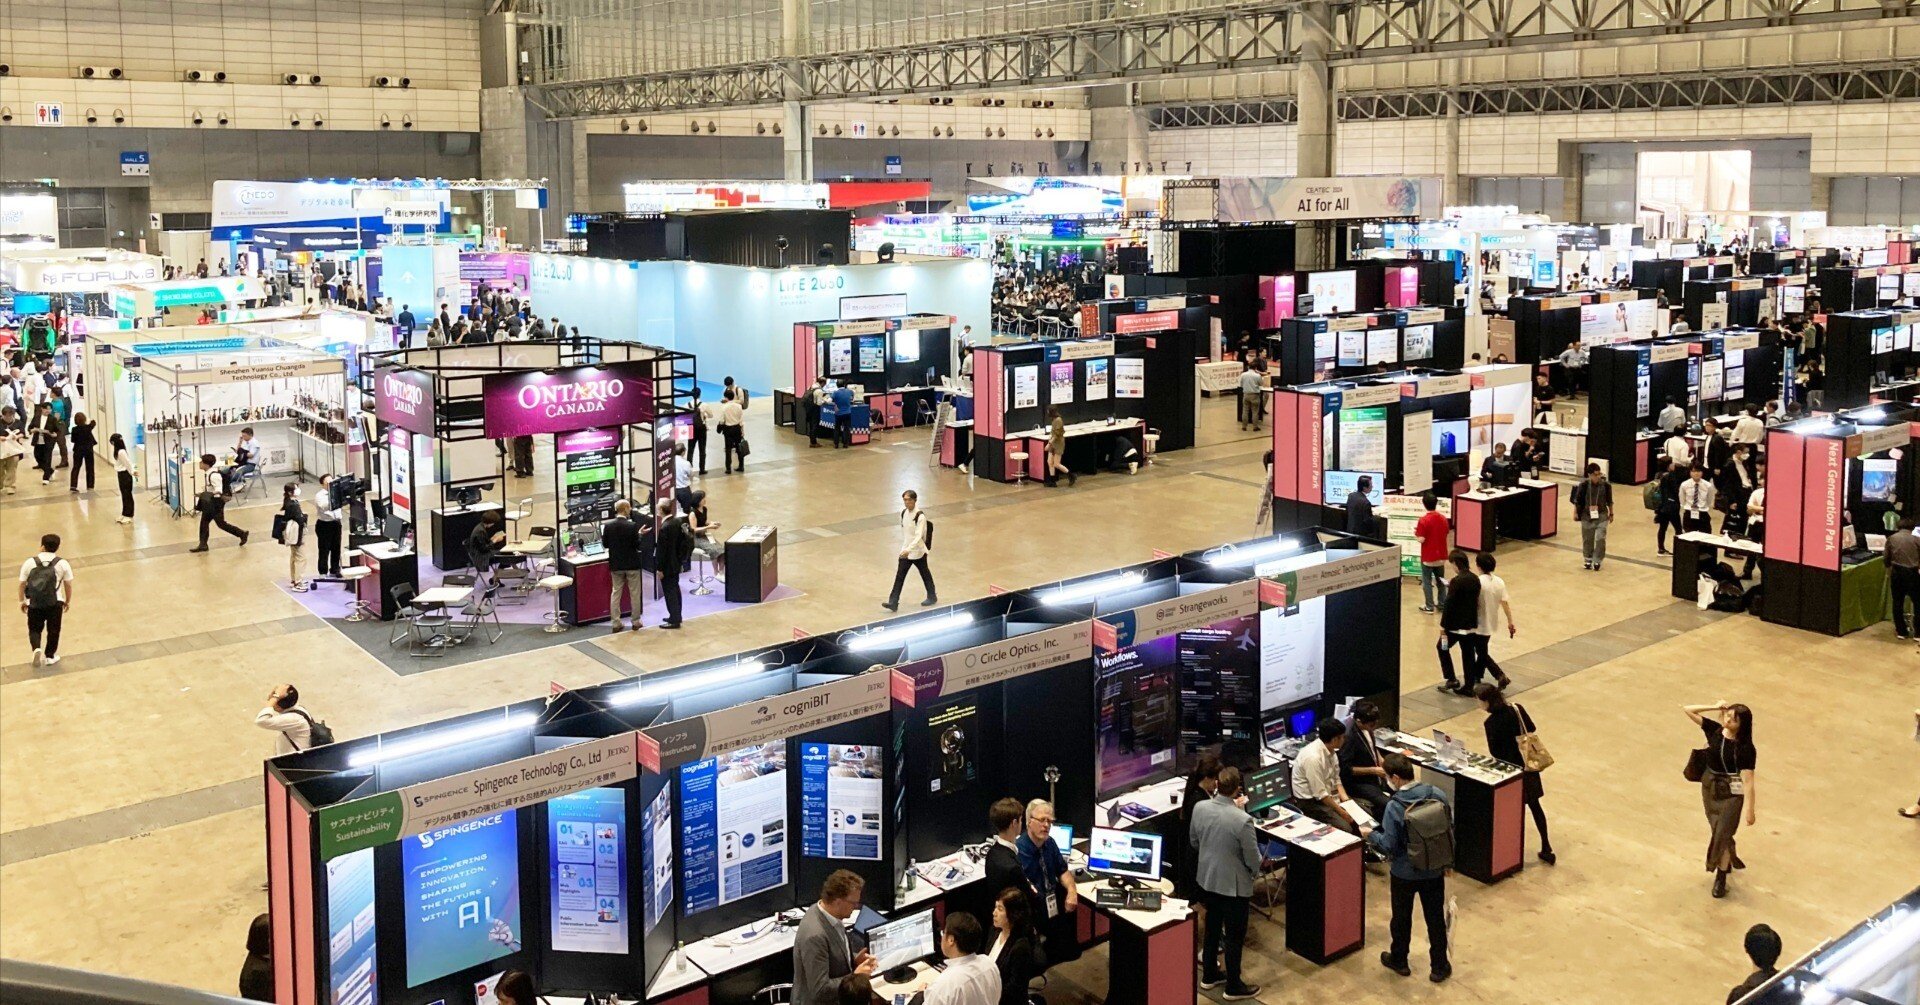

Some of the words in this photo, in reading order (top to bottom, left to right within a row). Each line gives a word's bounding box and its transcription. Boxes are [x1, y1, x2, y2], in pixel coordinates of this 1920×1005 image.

[139, 154, 144, 162] 5
[247, 191, 274, 199] NEDO
[394, 210, 438, 218] 理化学研究所
[1298, 199, 1311, 212] AI
[1316, 198, 1332, 212] for
[1334, 198, 1349, 210] All
[276, 364, 305, 372] Chuangda
[384, 374, 422, 406] ONTARIO
[518, 379, 624, 409] ONTARIO
[394, 398, 415, 415] CANADA
[546, 401, 605, 418] CANADA
[1828, 442, 1838, 466] Next
[1826, 470, 1838, 526] Generation
[1826, 528, 1836, 551] Park
[1320, 569, 1340, 579] Atmosic
[1342, 562, 1374, 574] Technologies
[1179, 595, 1228, 615] Strangeworks
[980, 650, 1007, 664] Circle
[1044, 638, 1059, 648] Inc.
[1101, 650, 1138, 668] Workflows.
[783, 693, 831, 715] cogniBIT
[866, 682, 885, 693] JETRO
[662, 732, 687, 744] インフラ
[424, 787, 468, 803] SPINGENCE
[474, 773, 518, 797] Spingence
[521, 761, 567, 783] Technology
[570, 755, 586, 769] Co.,
[589, 751, 601, 764] Ltd
[606, 745, 629, 760] JETRO
[424, 771, 616, 828] デジタル競争力の強化に資する包括的AIソリューションを提供
[330, 806, 394, 829] サステナビリティ
[336, 822, 391, 841] Sustainability
[434, 814, 502, 841] SPINGENCE
[560, 824, 573, 834] 01
[599, 844, 613, 854] 02
[420, 853, 488, 878] EMPOWERING
[421, 865, 486, 889] INNOVATION,
[579, 877, 594, 887] 03
[421, 882, 467, 900] SHAPING
[421, 901, 441, 911] THE
[444, 888, 482, 905] FUTURE
[458, 896, 491, 929] AI
[600, 899, 615, 908] 04
[421, 910, 449, 923] WITH
